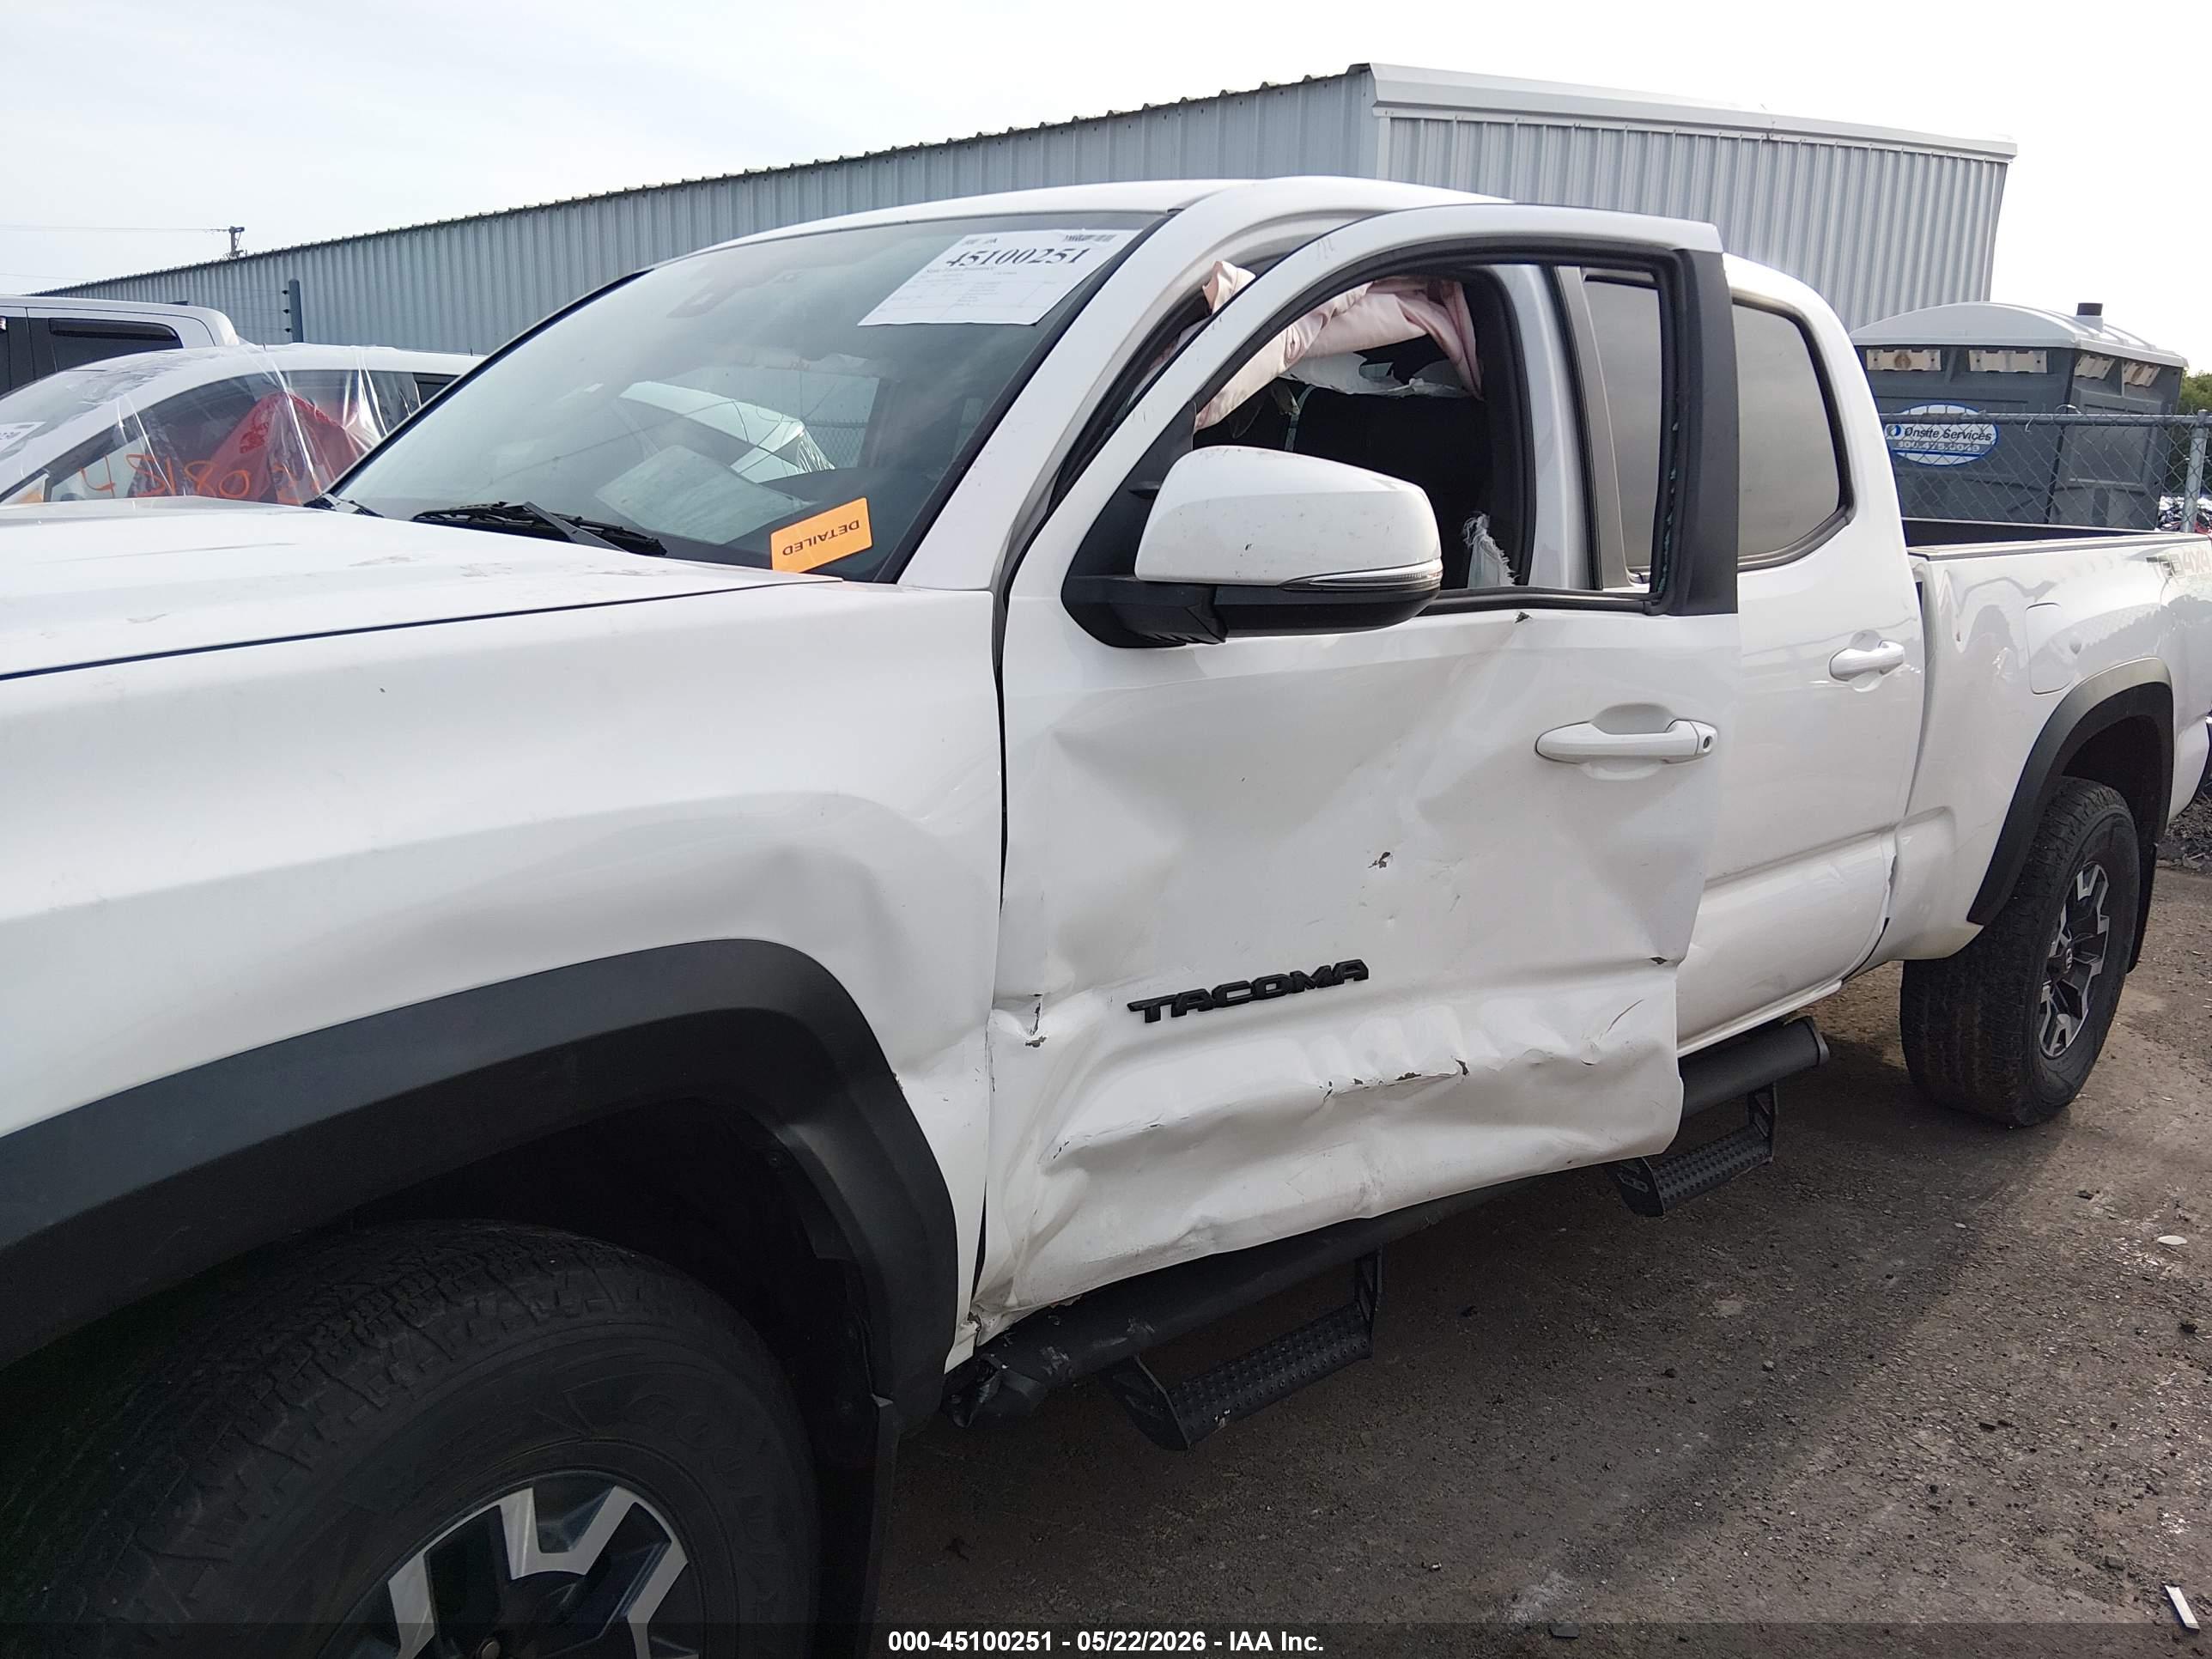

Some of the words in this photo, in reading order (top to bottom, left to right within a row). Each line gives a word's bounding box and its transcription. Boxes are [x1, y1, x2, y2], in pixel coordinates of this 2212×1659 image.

[946, 247, 1091, 267] 45100251
[1905, 427, 1940, 439] Onsite
[1942, 428, 1992, 441] Services
[782, 520, 860, 556] DETAILED
[1127, 958, 1370, 1024] TACOMA
